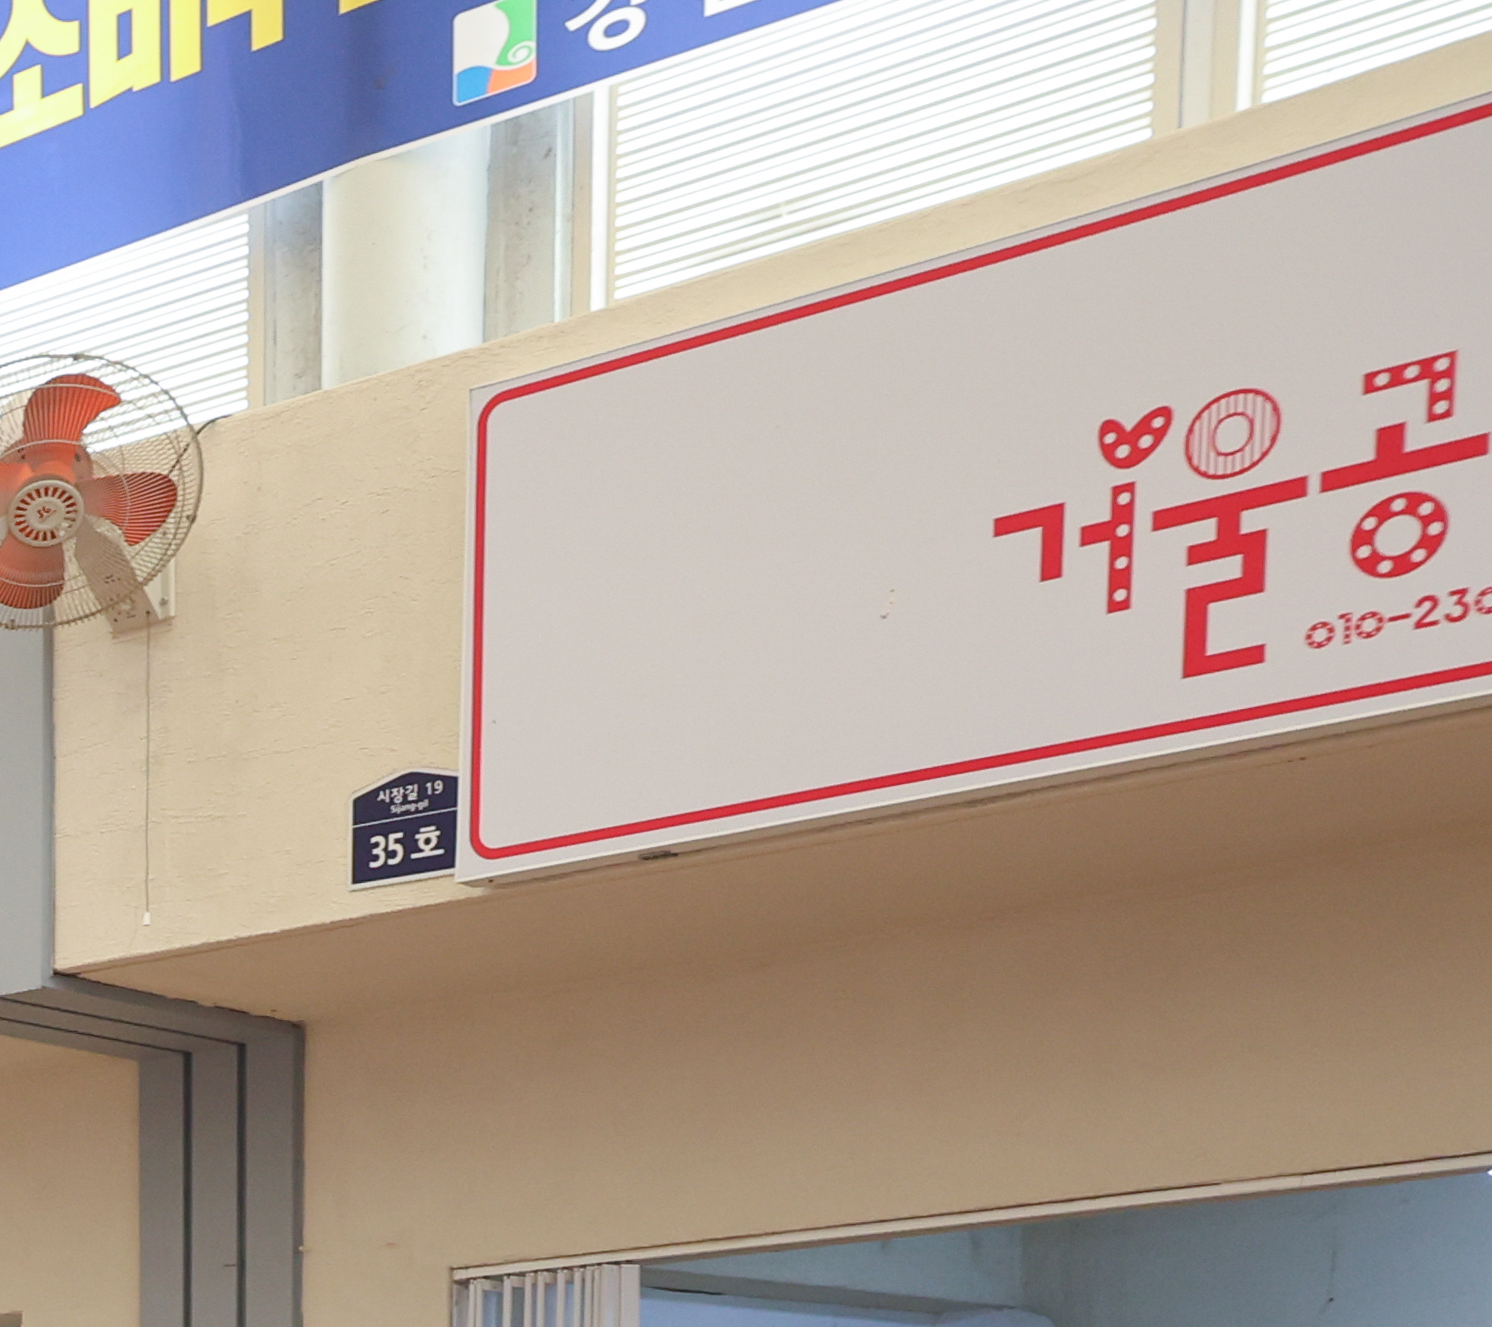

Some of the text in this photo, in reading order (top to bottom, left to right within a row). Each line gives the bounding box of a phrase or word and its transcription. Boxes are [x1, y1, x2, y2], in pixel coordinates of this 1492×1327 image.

[377, 780, 444, 803] 시장길 19
[369, 825, 445, 868] 35 호
